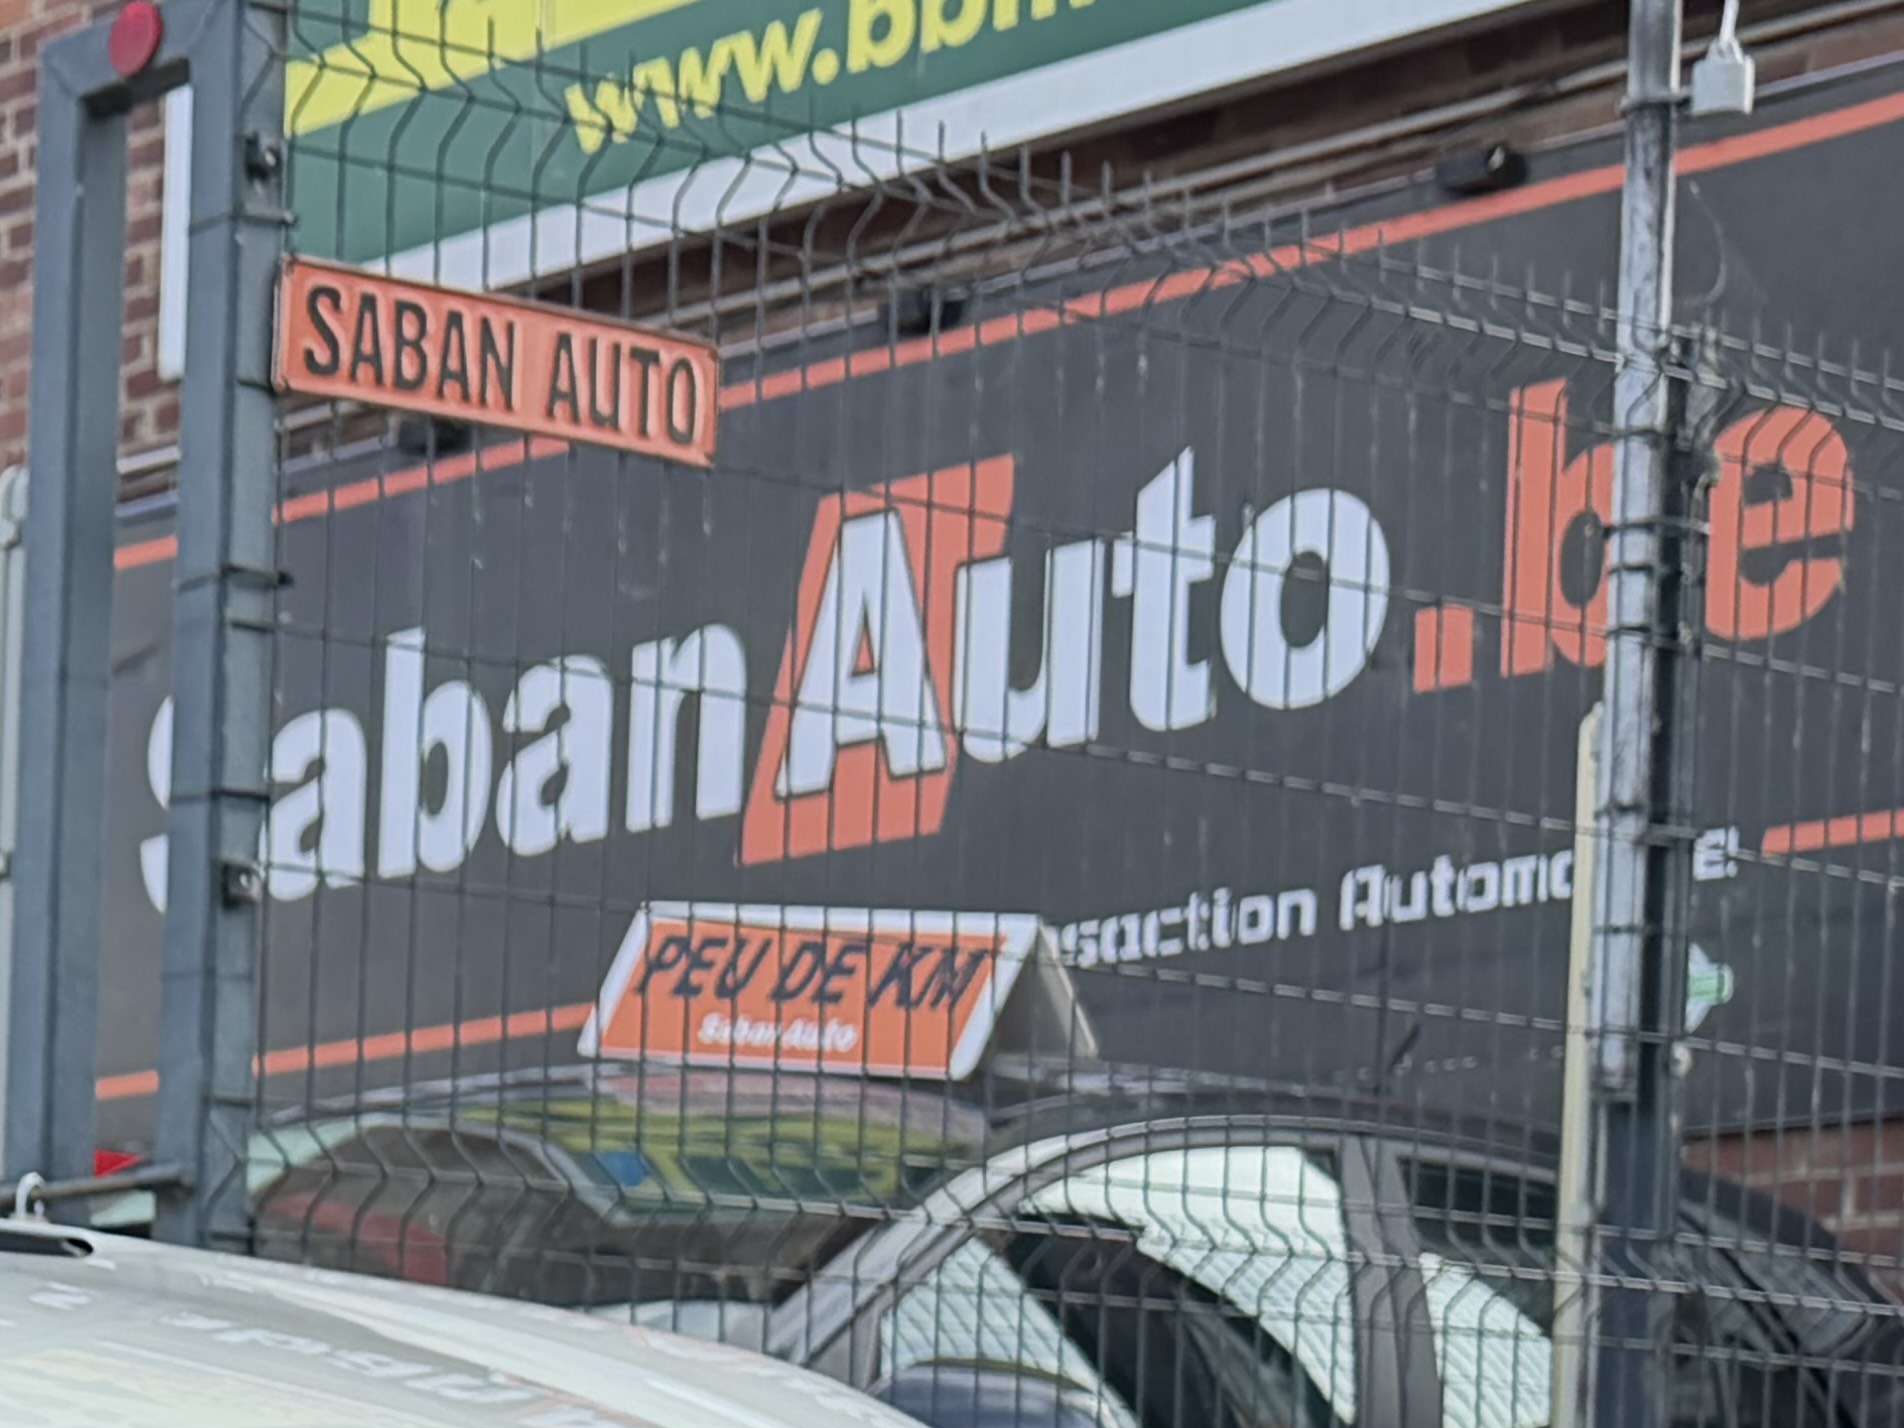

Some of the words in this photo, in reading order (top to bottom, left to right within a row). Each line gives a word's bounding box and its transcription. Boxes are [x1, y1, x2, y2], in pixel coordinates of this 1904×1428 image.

[565, 0, 1097, 153] www.bb
[303, 285, 515, 411] SABAN
[548, 332, 700, 446] AUTO
[140, 379, 1855, 912] abanAuto.be
[633, 933, 772, 1000] PEU
[767, 941, 868, 1003] DE
[868, 943, 990, 1011] KM
[1034, 887, 1317, 967] saction
